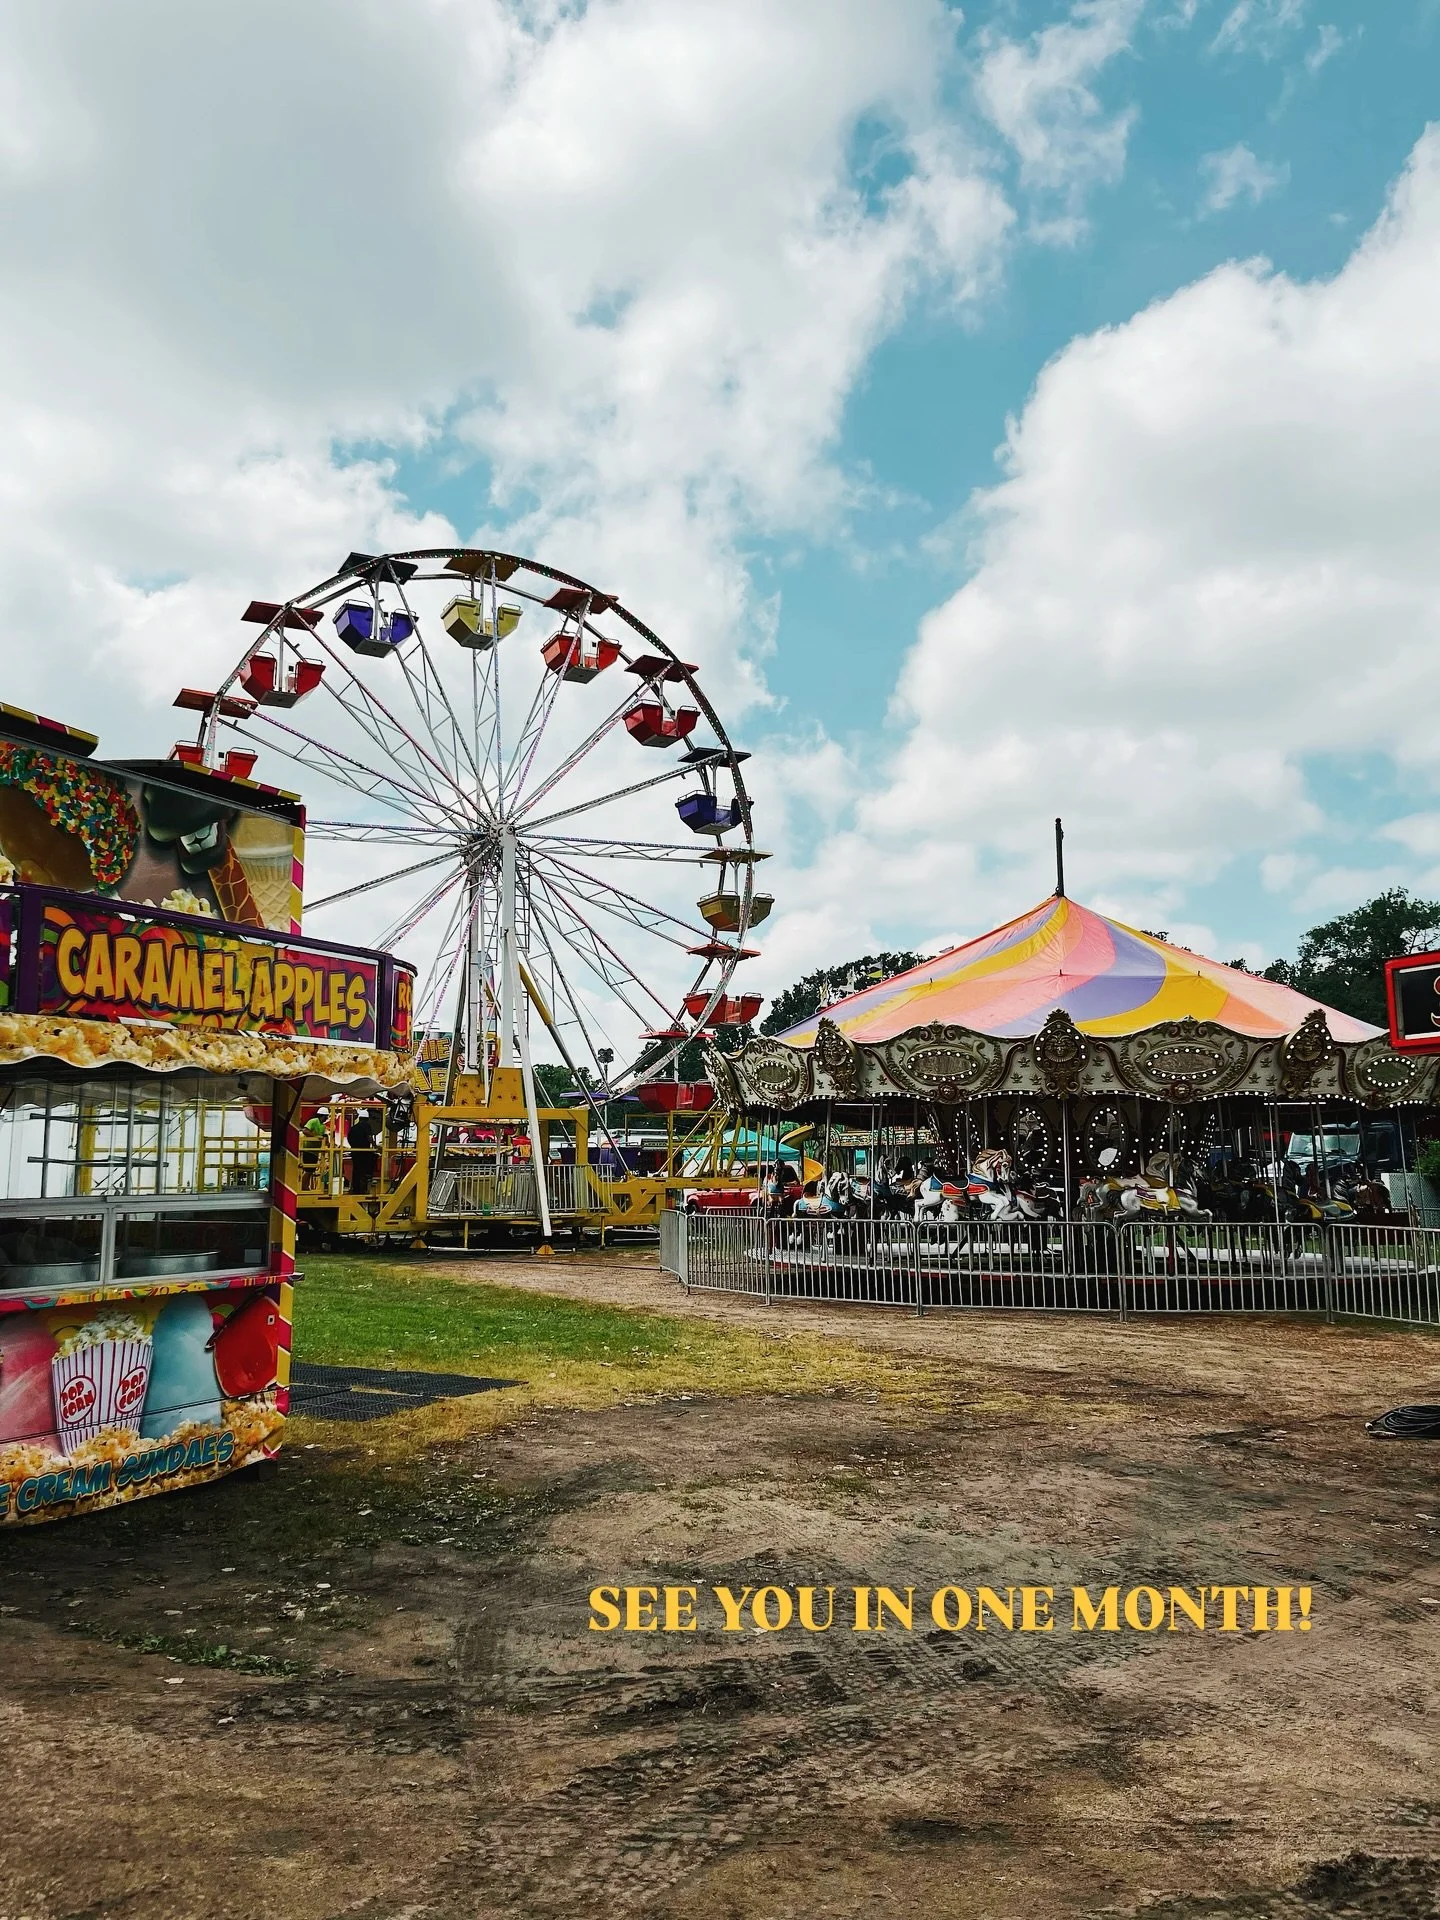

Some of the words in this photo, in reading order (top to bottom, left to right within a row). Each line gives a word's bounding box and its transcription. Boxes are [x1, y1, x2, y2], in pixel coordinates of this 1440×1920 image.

[57, 925, 244, 1013] CARAMEL
[249, 957, 367, 1031] APPLES
[61, 1381, 85, 1406] POP
[120, 1371, 144, 1396] POP
[63, 1390, 94, 1418] CORN
[17, 1461, 112, 1512] CREAM
[117, 1430, 236, 1487] SUNDAES
